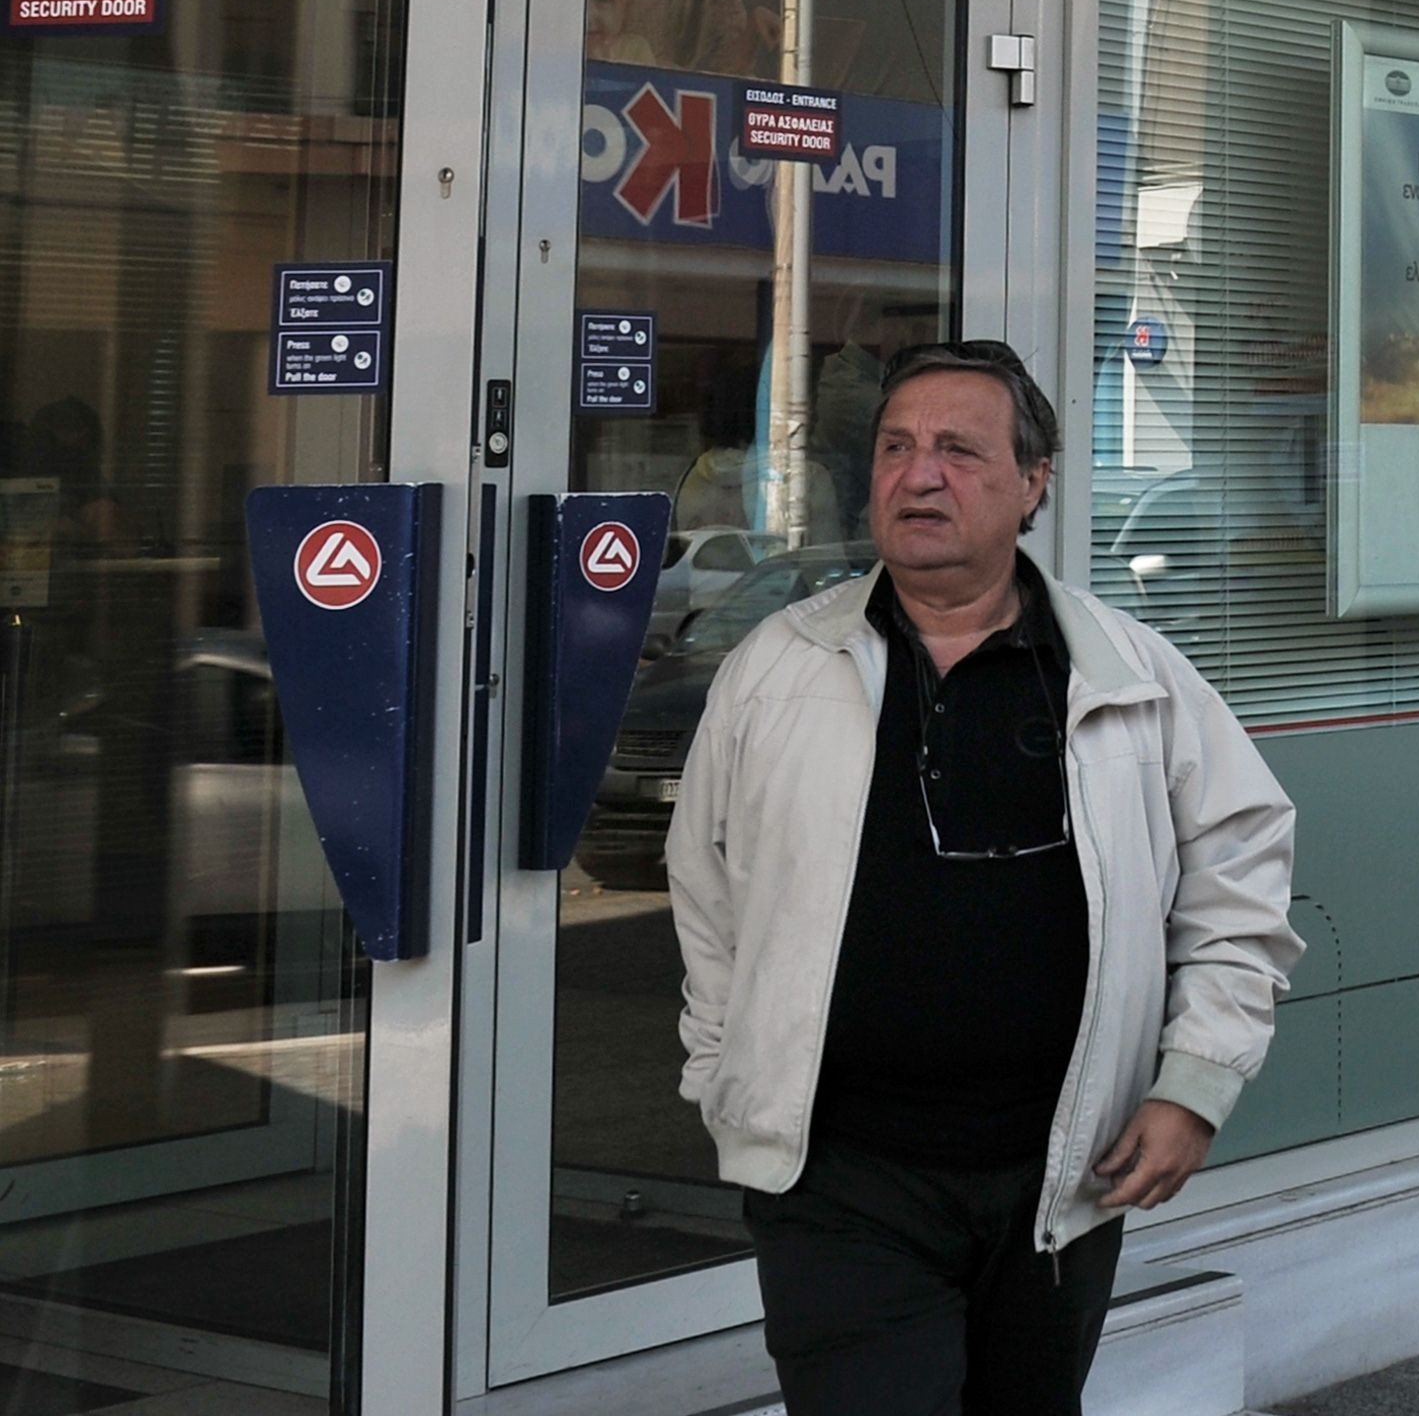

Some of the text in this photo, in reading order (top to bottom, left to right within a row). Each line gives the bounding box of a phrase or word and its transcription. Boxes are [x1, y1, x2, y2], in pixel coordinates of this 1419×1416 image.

[19, 0, 147, 18] SECURITY DOOR
[746, 89, 785, 105] ΕΙΣΟΔΟΣ
[792, 93, 838, 110] ENTRANCE
[748, 112, 834, 134] ΘΥΡΑ ΑΣΦΑΛΕΙΑΣ
[750, 130, 831, 150] SECURITY DOOR
[286, 340, 311, 350] Press
[285, 372, 338, 382] Pull the door
